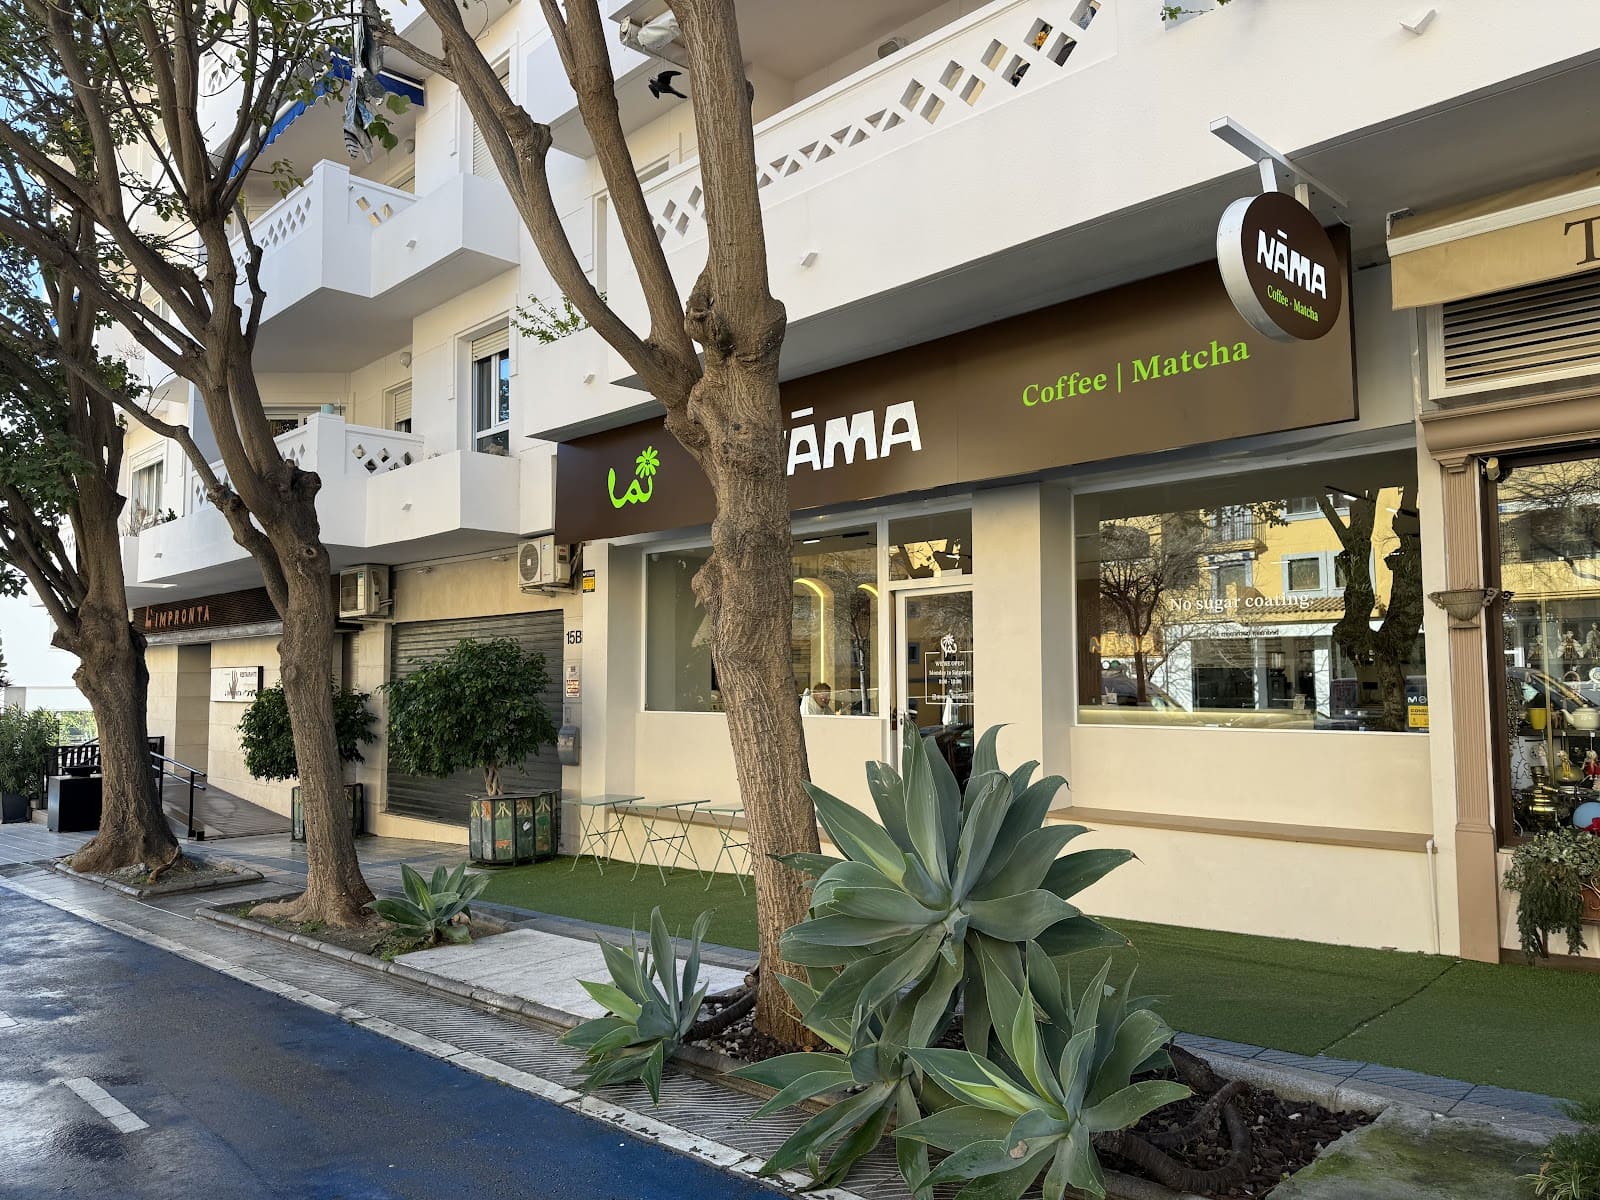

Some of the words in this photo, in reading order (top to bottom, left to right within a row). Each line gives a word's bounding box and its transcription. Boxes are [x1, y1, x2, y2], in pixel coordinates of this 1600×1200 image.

[1267, 285, 1289, 307] Coffee
[1293, 299, 1319, 322] Matcha
[1021, 371, 1108, 407] Coffee
[1131, 340, 1250, 384] Matcha
[784, 400, 922, 476] ĀMA
[144, 605, 210, 630] L'IMPRONTA
[1170, 597, 1192, 611] No
[1196, 598, 1241, 613] sugar
[1245, 592, 1314, 609] coating.
[566, 630, 583, 645] 15B
